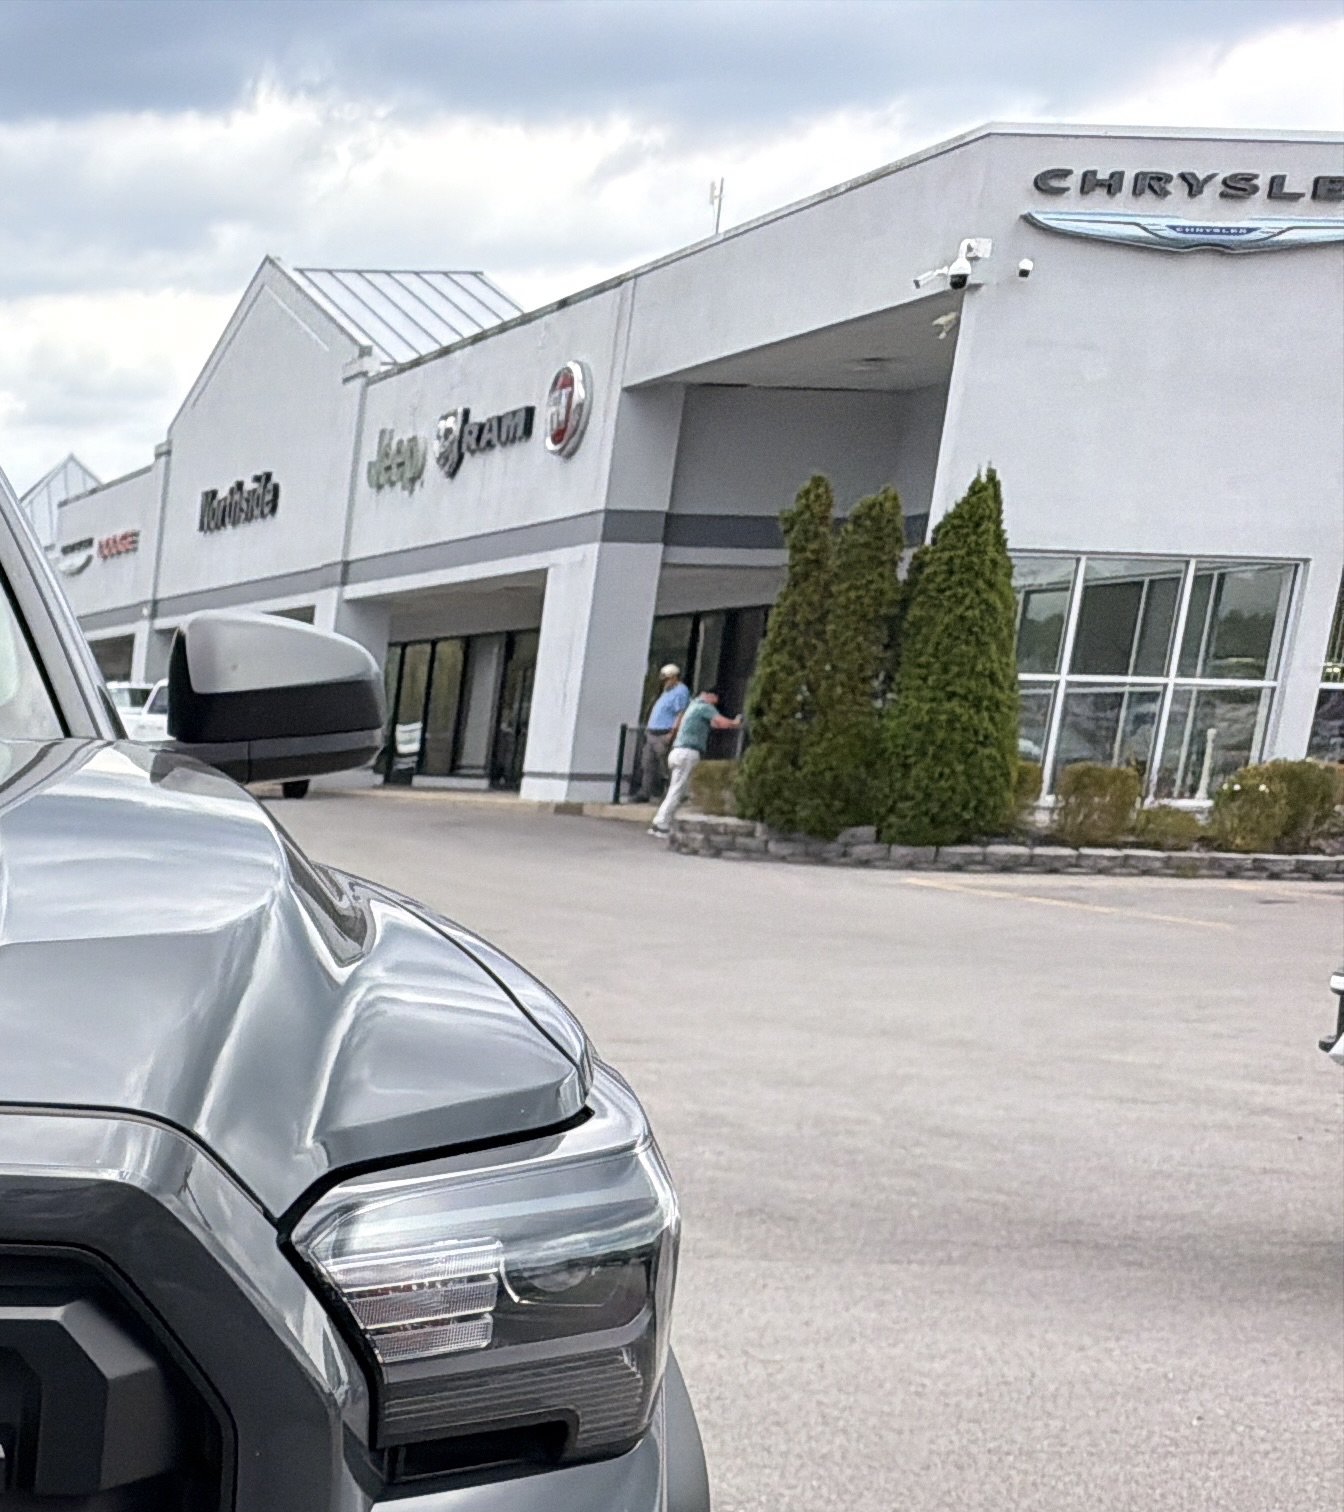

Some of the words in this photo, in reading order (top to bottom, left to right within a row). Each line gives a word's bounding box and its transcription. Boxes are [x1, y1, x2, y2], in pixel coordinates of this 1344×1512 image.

[367, 428, 428, 495] Jeep
[463, 406, 535, 455] RAM
[199, 471, 279, 534] Northside
